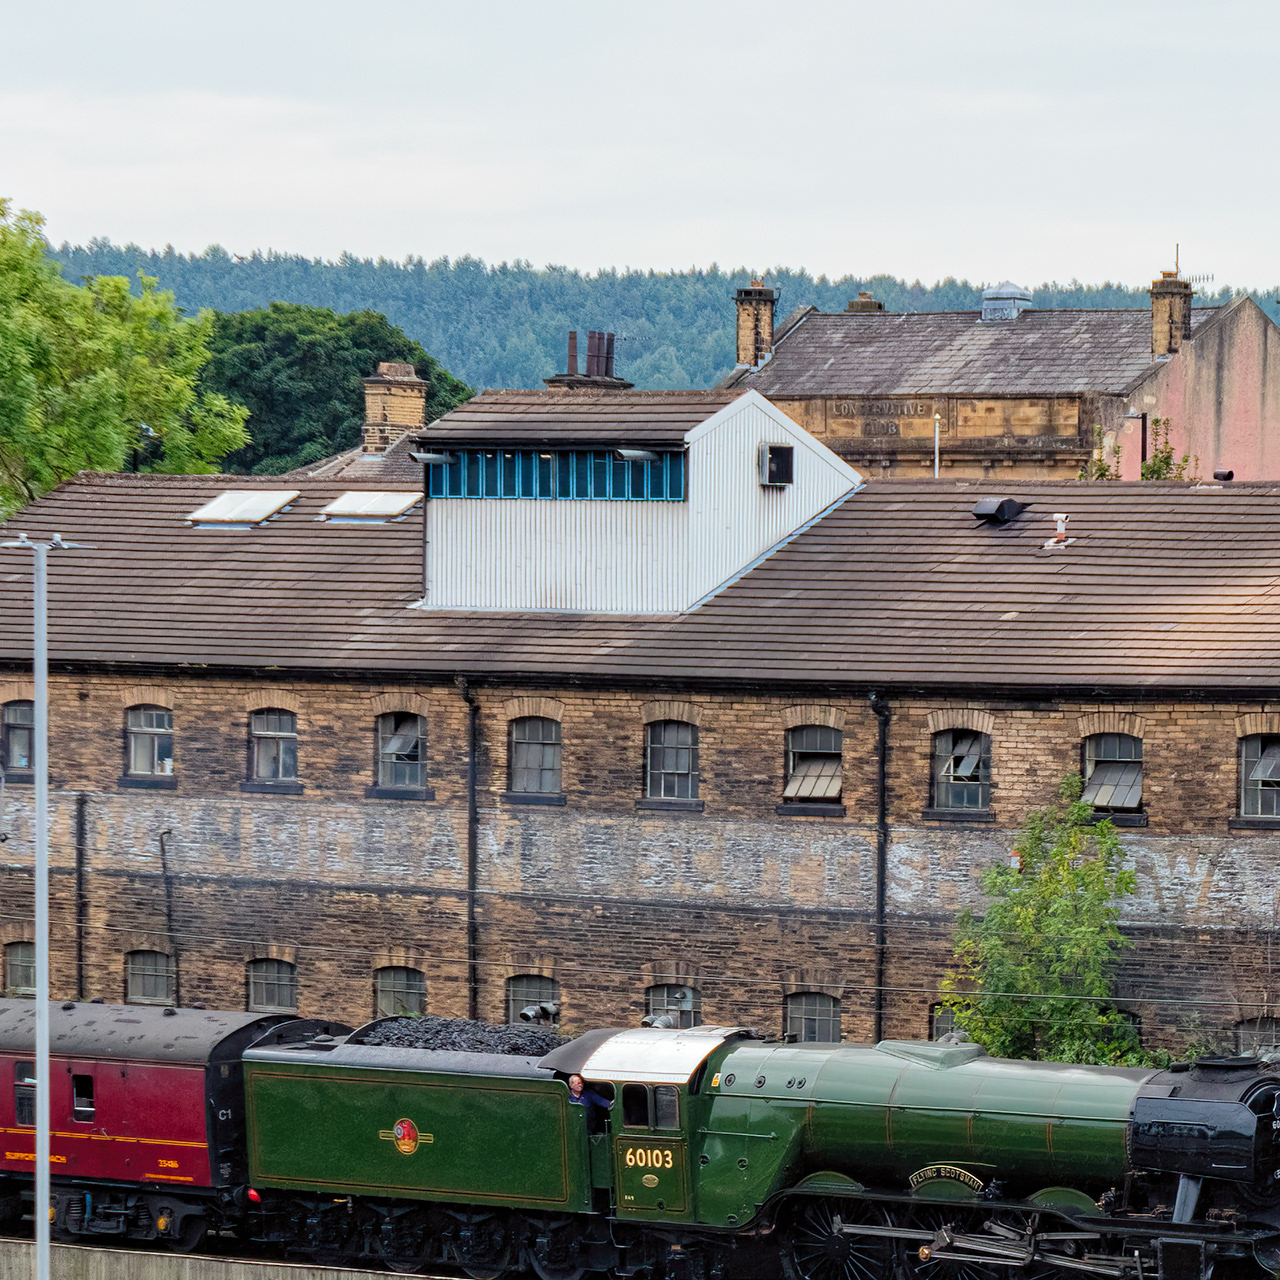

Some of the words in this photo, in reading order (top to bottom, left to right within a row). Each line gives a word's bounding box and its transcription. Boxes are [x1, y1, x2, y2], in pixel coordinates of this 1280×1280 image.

[218, 1109, 232, 1120] C1
[626, 1148, 673, 1169] 60103
[912, 1168, 938, 1186] FLYING
[940, 1167, 983, 1192] SCOTSMAN
